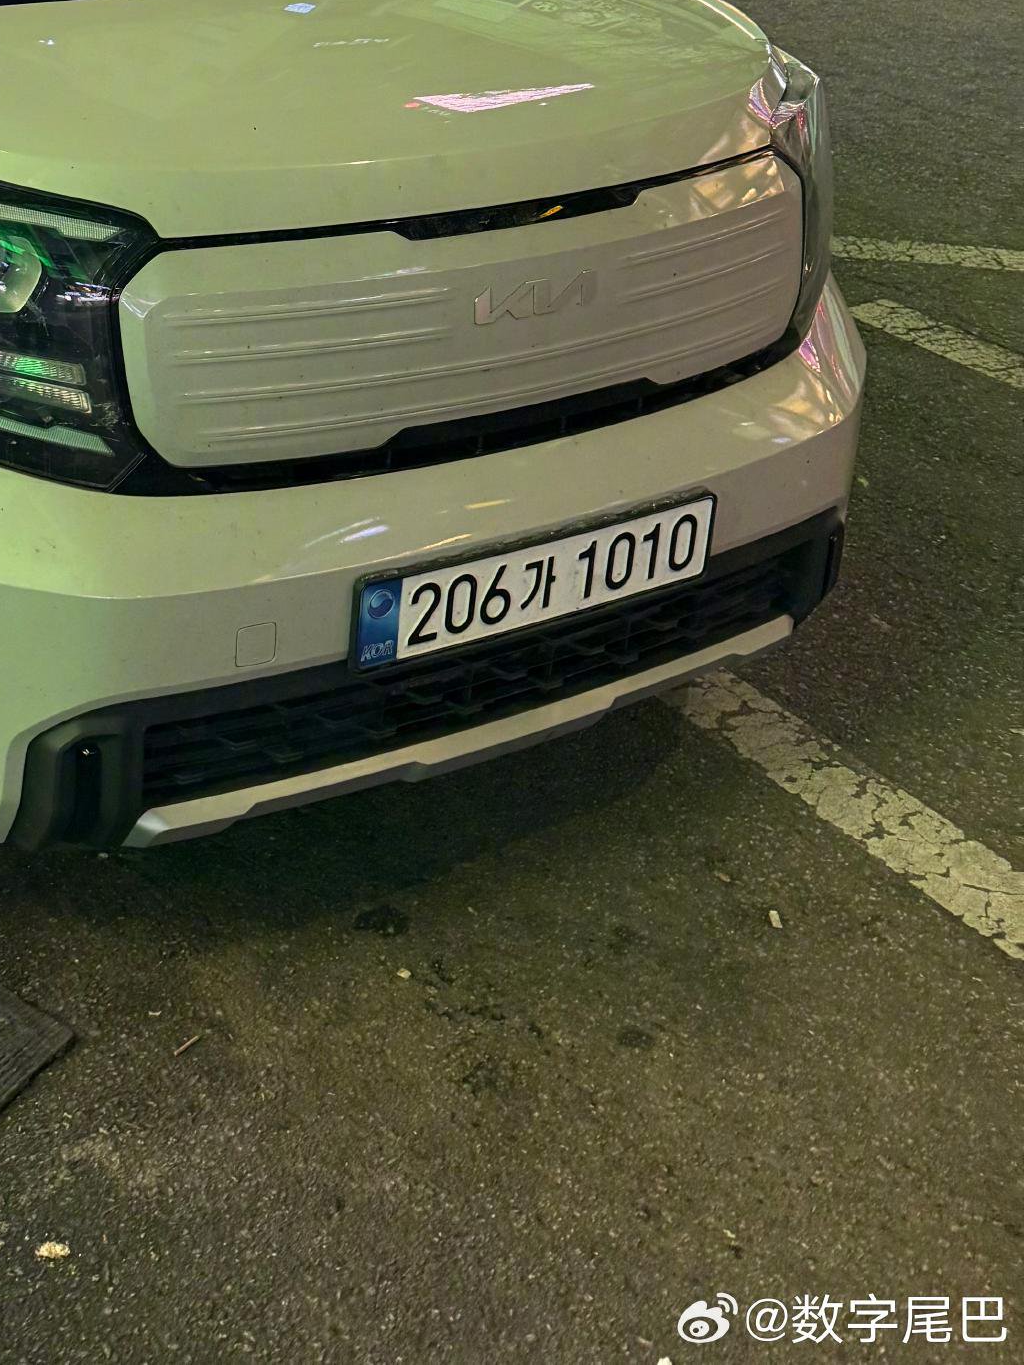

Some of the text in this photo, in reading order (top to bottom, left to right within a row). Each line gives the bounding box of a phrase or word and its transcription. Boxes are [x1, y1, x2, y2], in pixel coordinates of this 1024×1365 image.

[474, 268, 594, 326] KIA
[407, 513, 698, 648] 206가 1010
[360, 639, 394, 662] KOR
